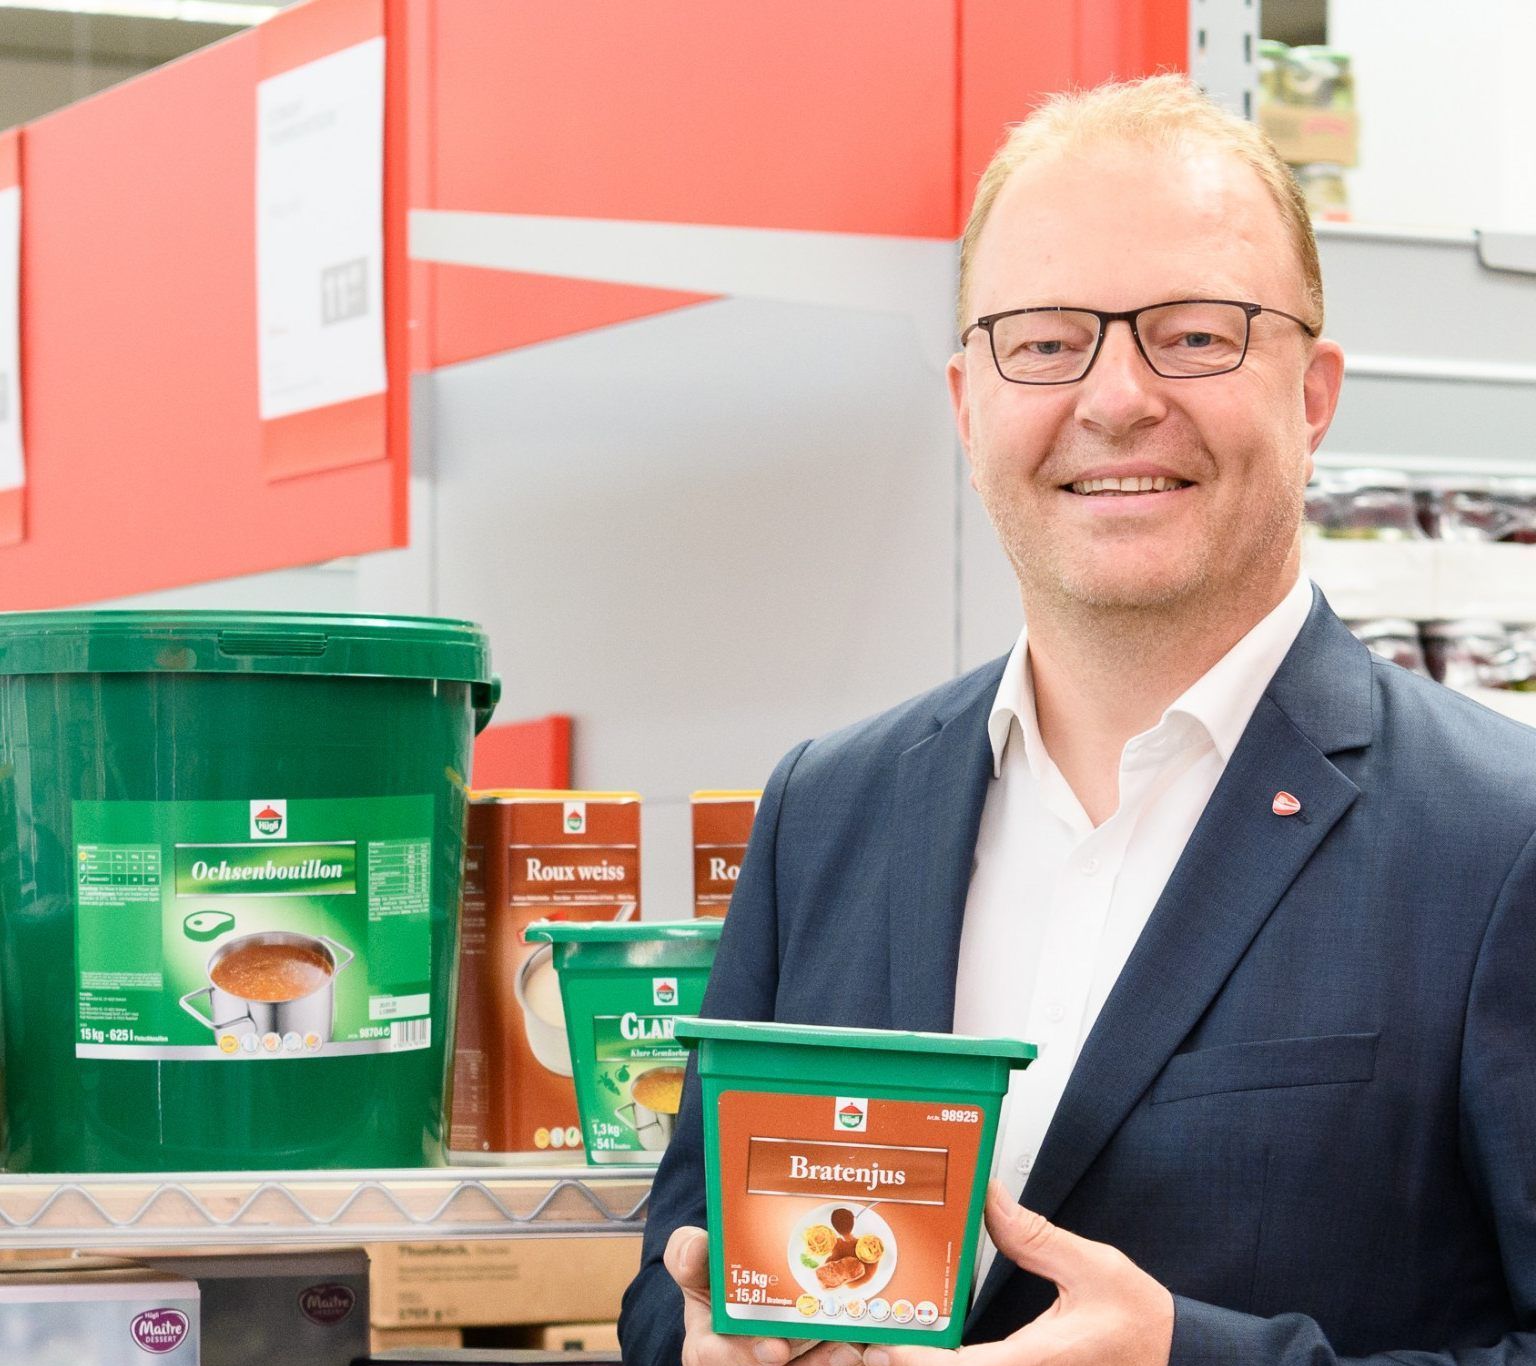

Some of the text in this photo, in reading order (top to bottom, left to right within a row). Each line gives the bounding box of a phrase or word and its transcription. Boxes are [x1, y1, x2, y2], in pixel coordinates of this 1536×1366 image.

[259, 820, 279, 833] Hügli
[191, 859, 342, 881] Ochsenbouillon
[526, 858, 625, 881] Roux weiss
[941, 1109, 979, 1123] 98925
[789, 1155, 906, 1191] Bratenjus
[139, 1320, 182, 1336] Maître
[145, 1335, 177, 1344] DESSERT
